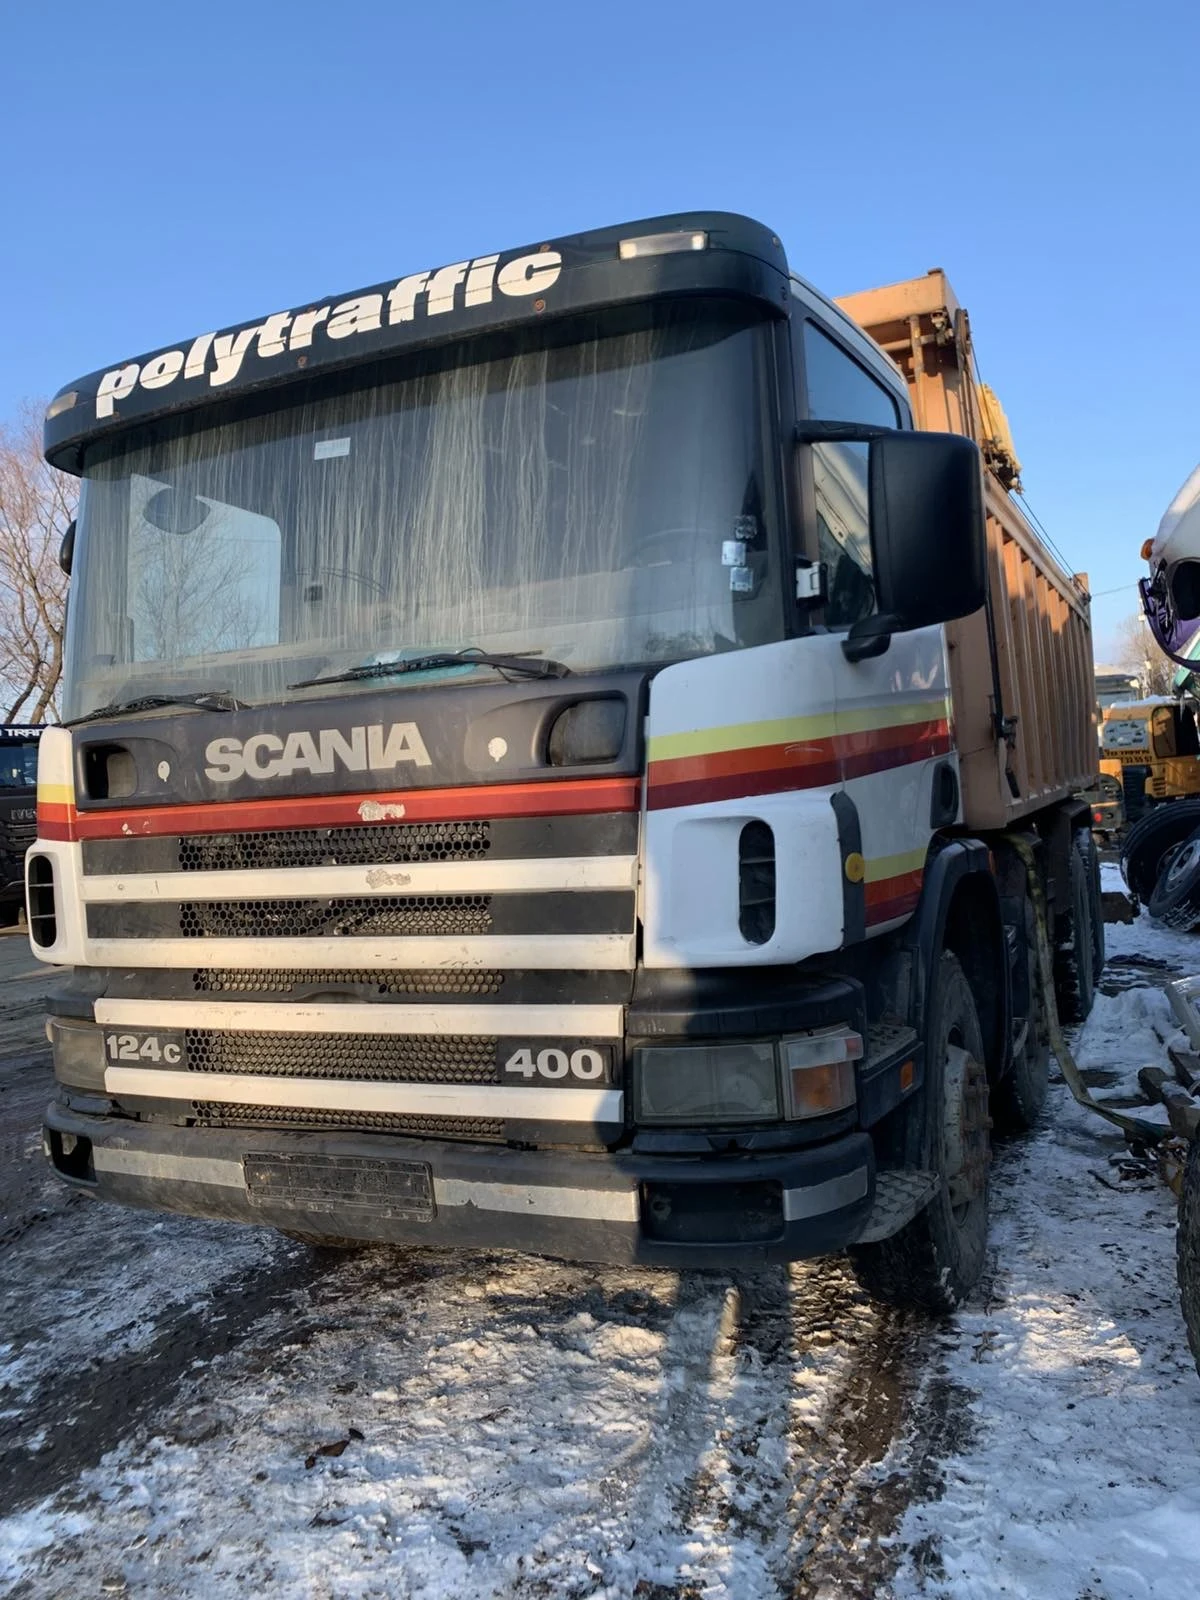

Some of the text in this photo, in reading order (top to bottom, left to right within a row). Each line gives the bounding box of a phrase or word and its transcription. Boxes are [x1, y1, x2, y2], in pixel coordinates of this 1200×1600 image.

[96, 251, 562, 418] polytraffic
[204, 722, 432, 782] SCANIA
[11, 808, 37, 820] IVE
[505, 1048, 603, 1080] 400
